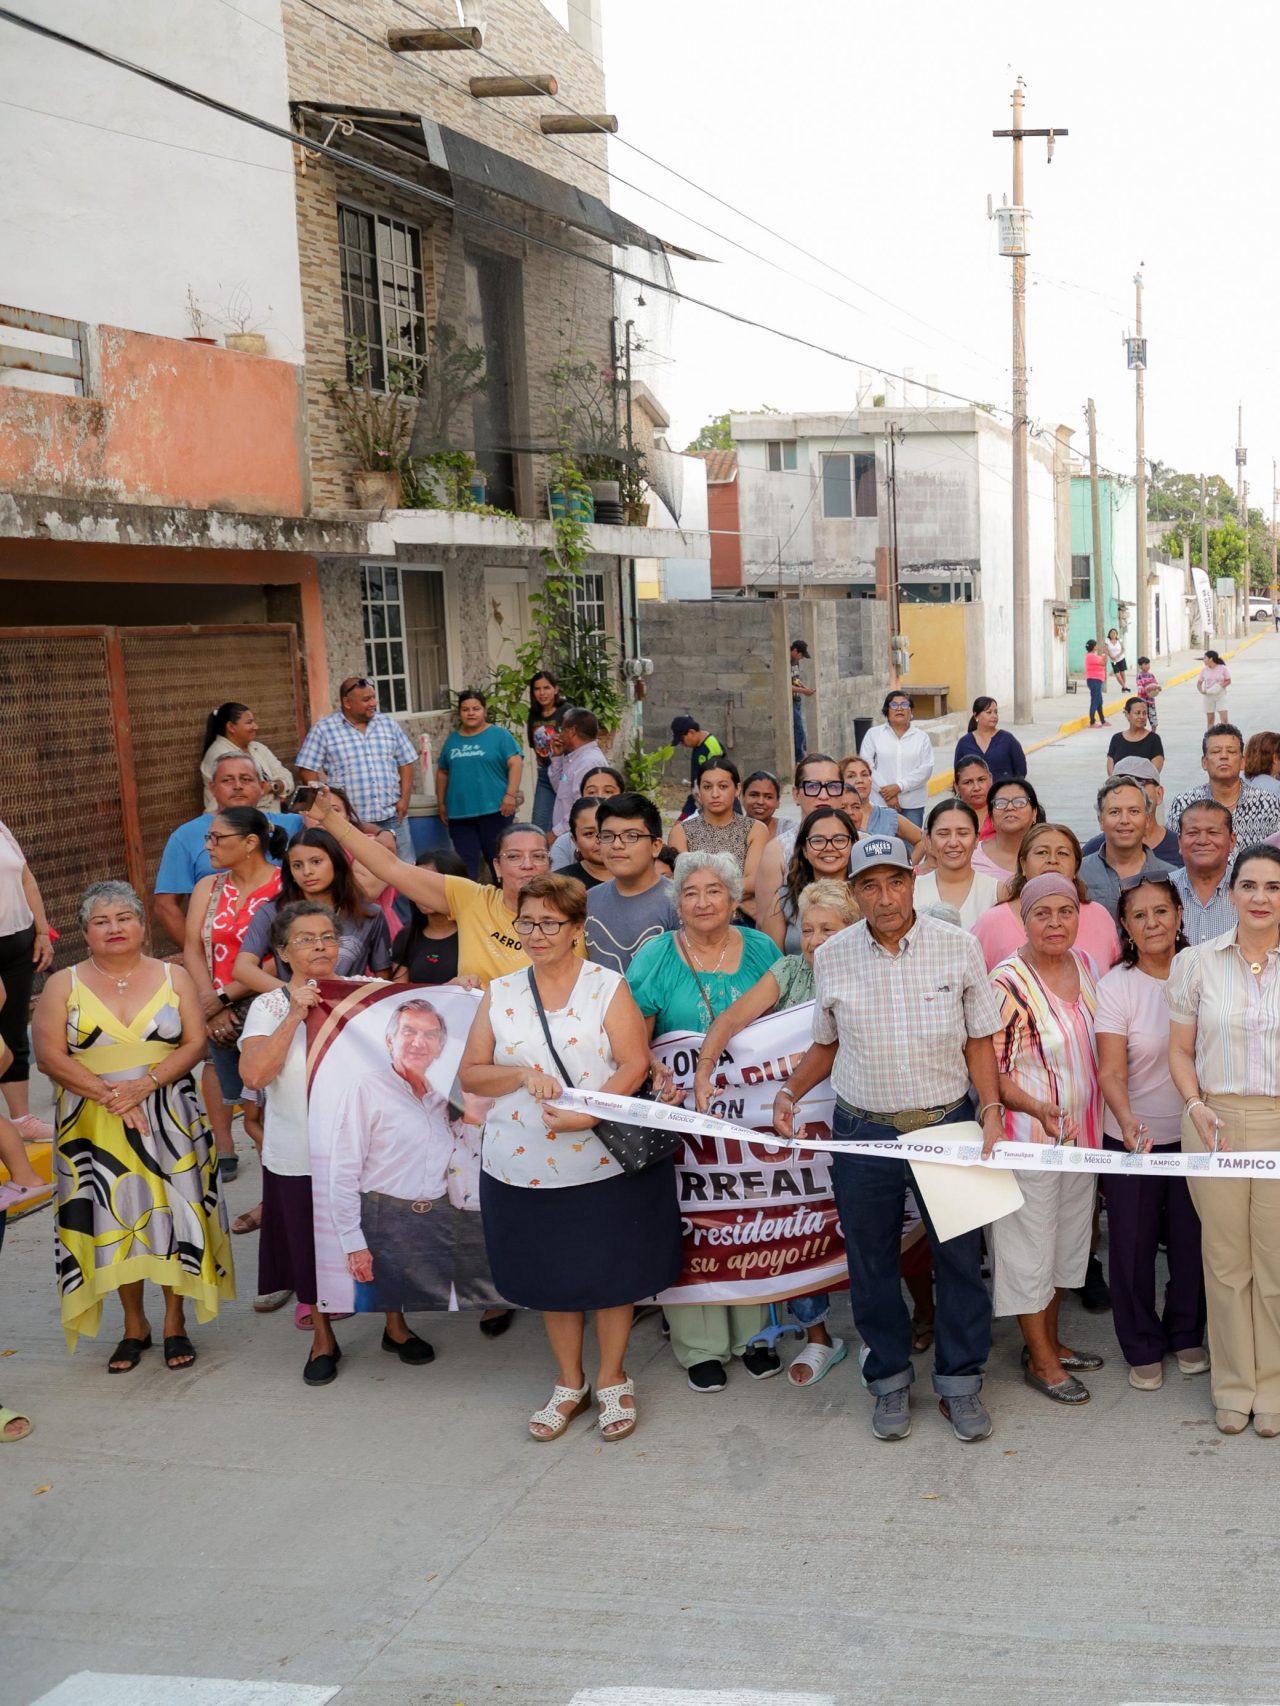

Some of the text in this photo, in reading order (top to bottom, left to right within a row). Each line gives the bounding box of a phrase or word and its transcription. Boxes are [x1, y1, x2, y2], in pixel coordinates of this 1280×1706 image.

[594, 1099, 623, 1109] Tamaulipas
[668, 1112, 695, 1123] México
[1003, 1151, 1035, 1159] Tamaulipas
[1084, 1155, 1112, 1164] México
[1150, 1159, 1181, 1167] TAMPICO
[1217, 1158, 1276, 1170] TAMPICO
[680, 1167, 828, 1201] RREAL
[681, 1205, 826, 1246] Presidenta
[690, 1236, 831, 1279] su apoyo!!!
